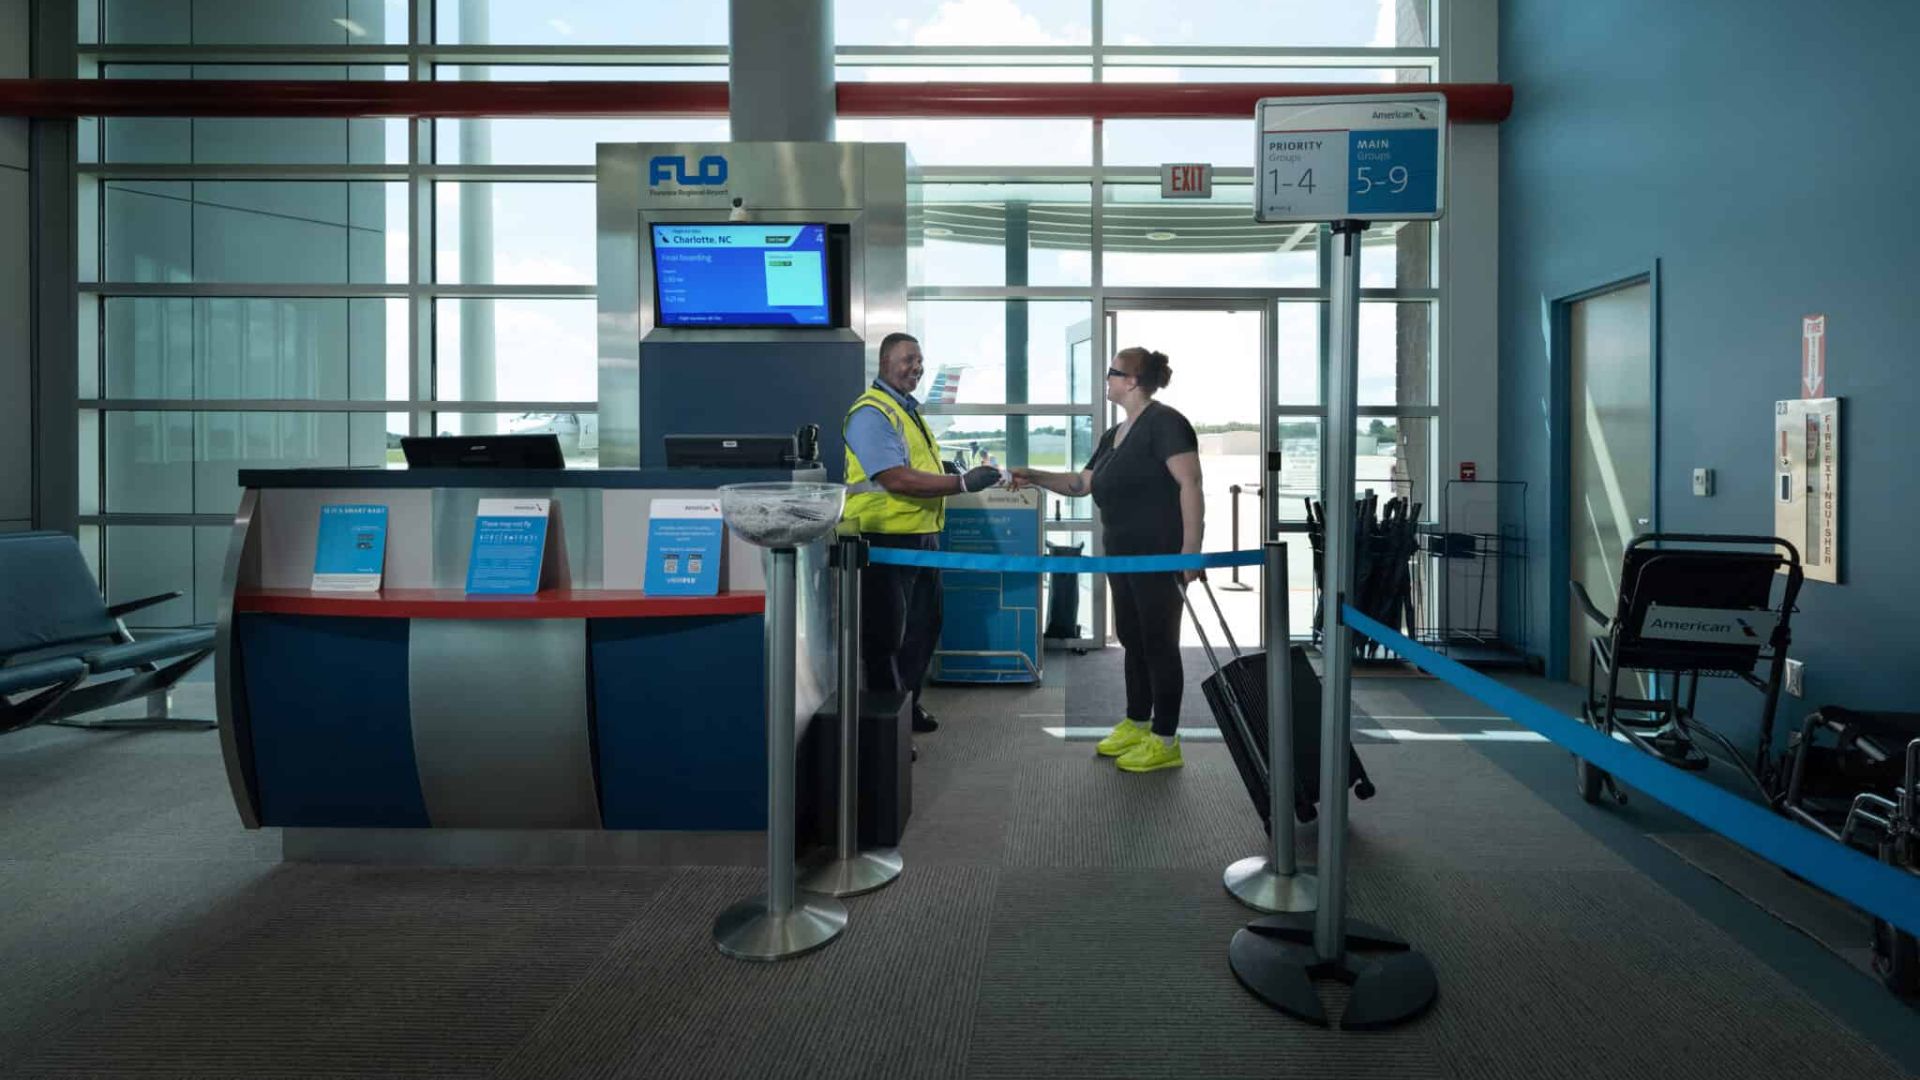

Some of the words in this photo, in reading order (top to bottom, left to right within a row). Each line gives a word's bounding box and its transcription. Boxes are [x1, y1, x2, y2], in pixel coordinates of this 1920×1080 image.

[1372, 110, 1413, 120] American
[1269, 140, 1323, 151] PRIORITY
[1356, 139, 1389, 149] MAIN
[1268, 153, 1302, 165] Groups
[1356, 151, 1391, 162] Groups
[649, 156, 728, 186] FLO
[1171, 166, 1204, 192] EXIT
[673, 235, 717, 245] Charlotte,
[718, 235, 733, 244] NC
[1806, 321, 1822, 334] FIRE
[1777, 402, 1788, 415] 23
[1824, 414, 1832, 451] FIRE
[1824, 455, 1832, 565] EXTINGUISHER
[1650, 618, 1731, 633] American
